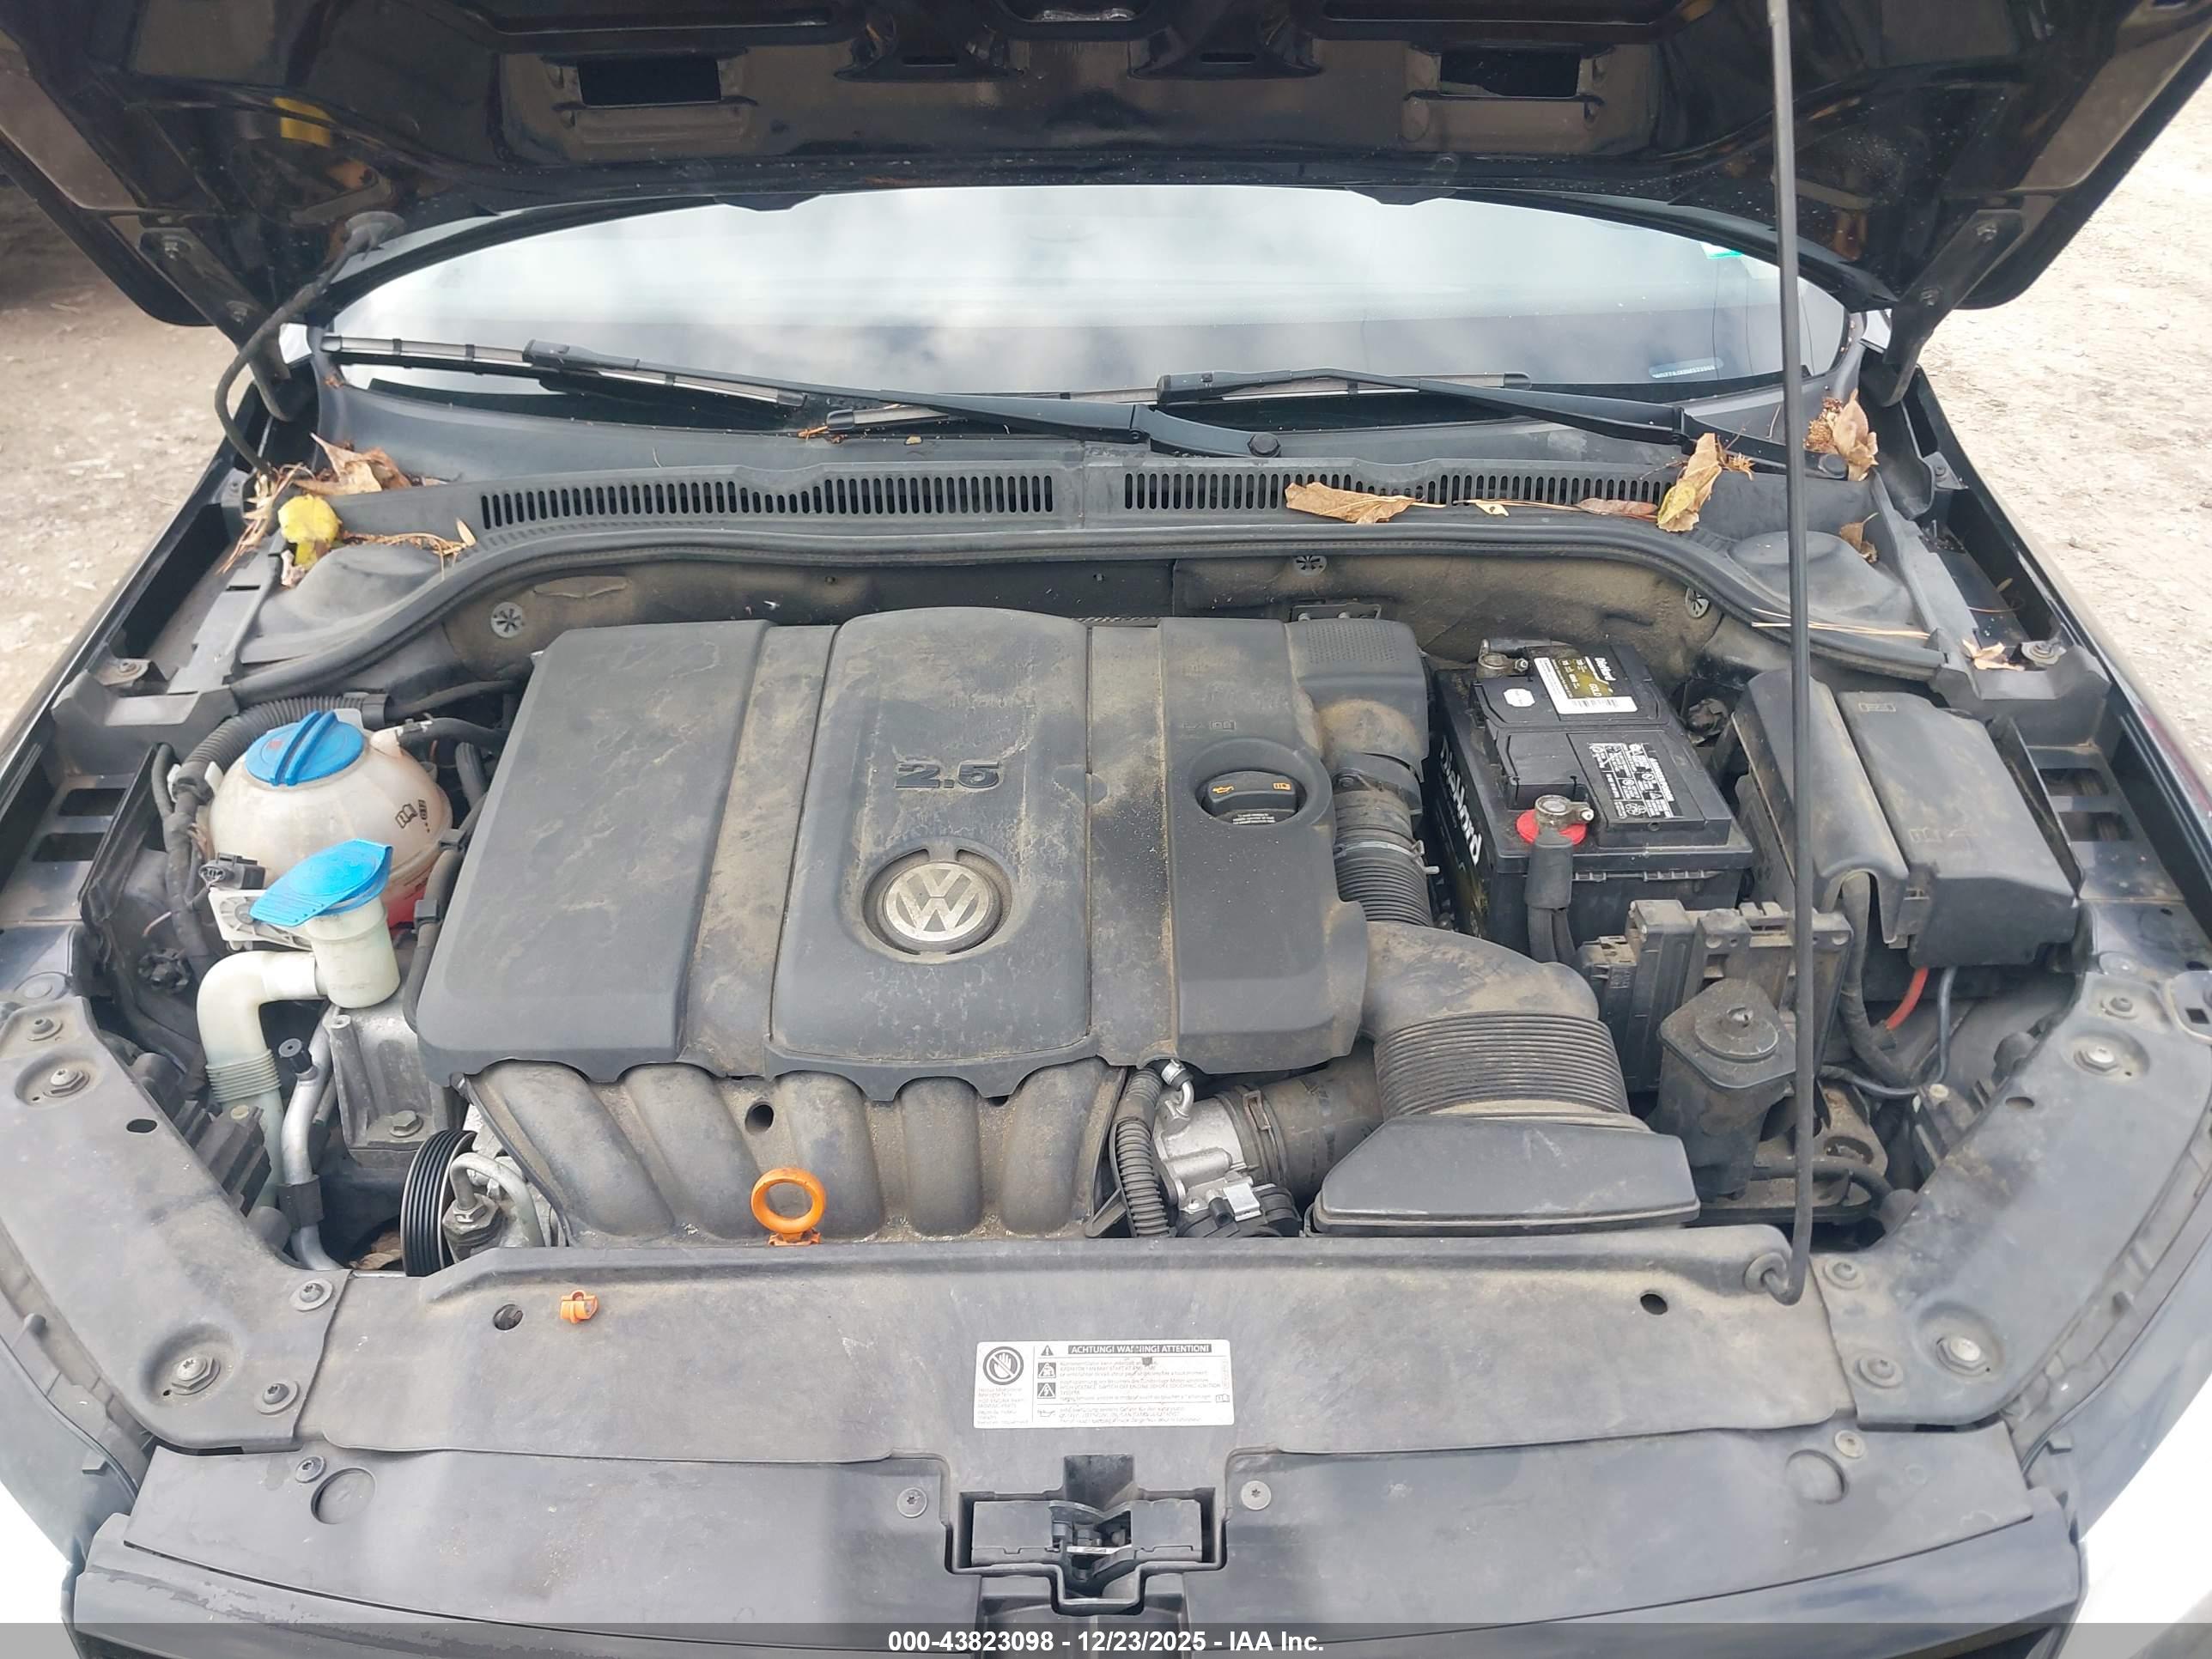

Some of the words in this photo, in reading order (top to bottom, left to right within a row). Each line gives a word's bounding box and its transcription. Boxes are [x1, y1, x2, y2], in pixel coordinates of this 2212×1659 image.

[1595, 657, 1617, 681] DieHard
[1589, 683, 1602, 696] GOLD
[894, 760, 1003, 788] 2.5
[1071, 1345, 1115, 1354] ACHTUNG!
[1161, 1344, 1209, 1353] ATTENTION!
